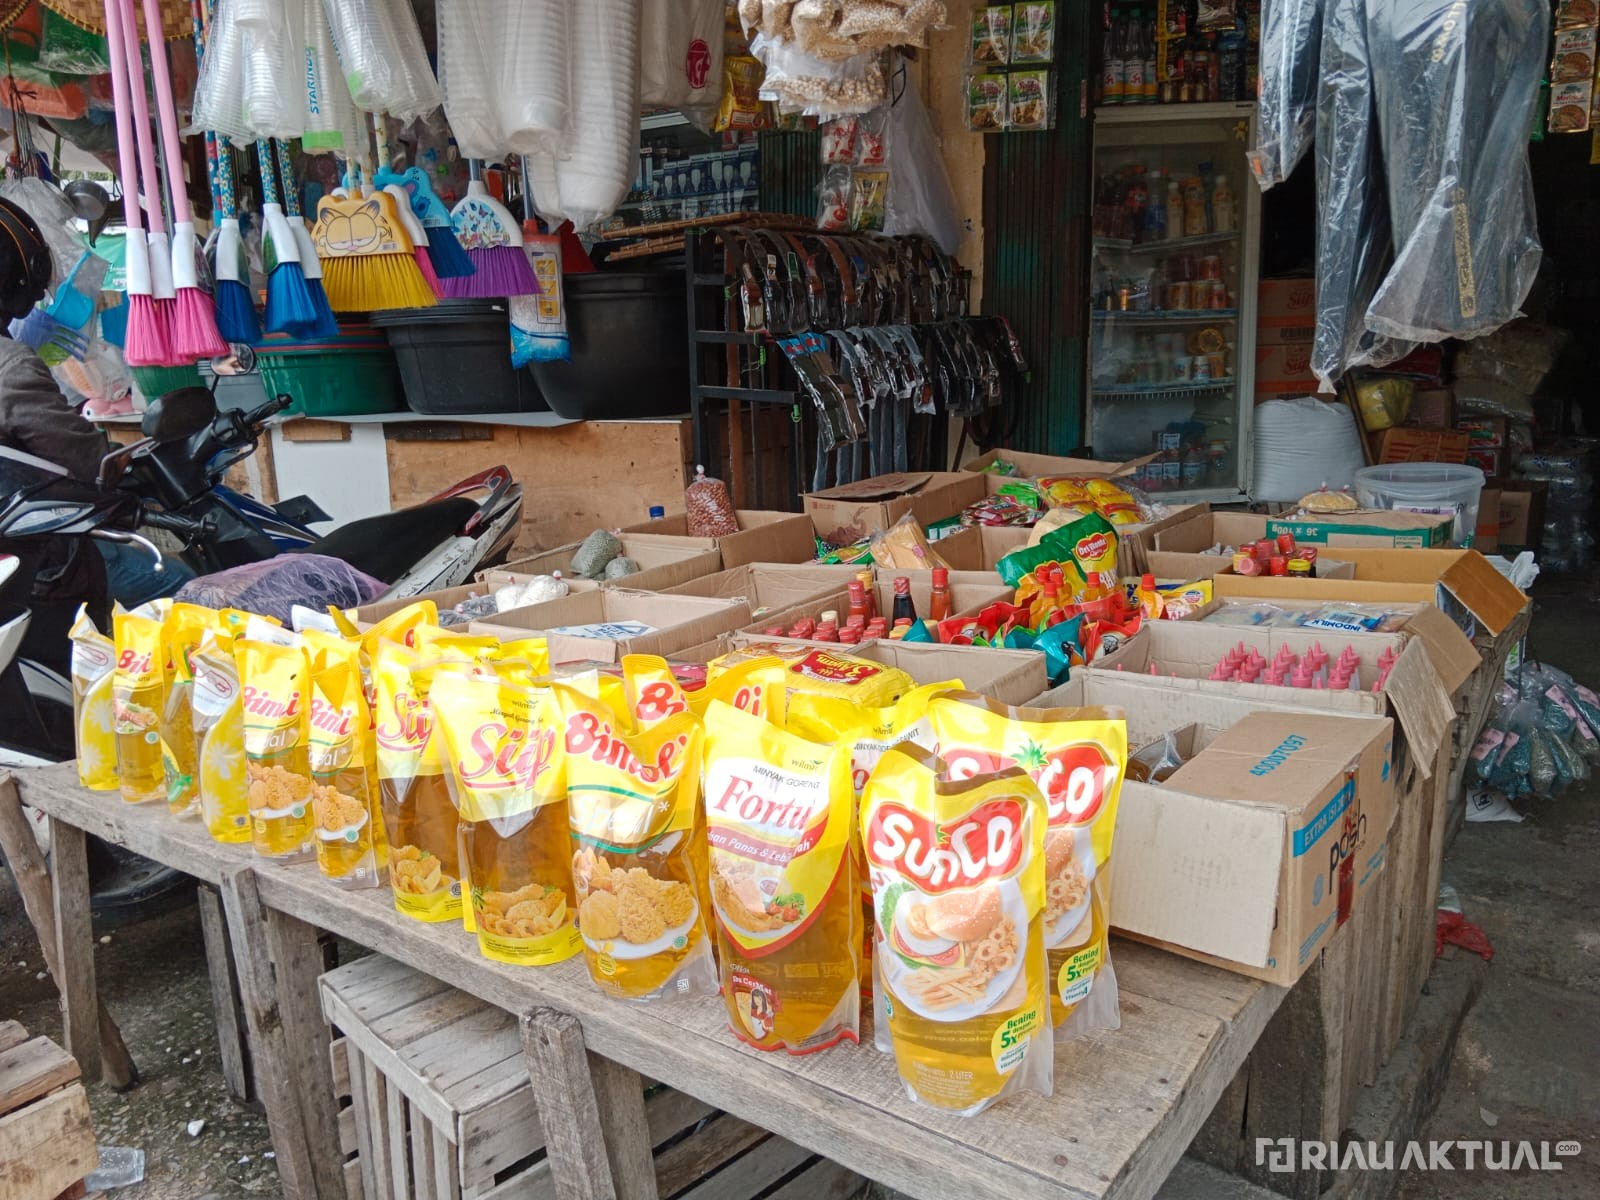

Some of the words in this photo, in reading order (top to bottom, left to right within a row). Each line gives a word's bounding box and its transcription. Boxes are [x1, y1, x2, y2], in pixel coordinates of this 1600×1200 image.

[1312, 619, 1361, 633] INDOMILK
[845, 665, 873, 678] 3
[1248, 734, 1308, 778] 40007097
[752, 764, 786, 783] MINYAK
[786, 777, 821, 790] GORENG
[950, 756, 1095, 820] SCO
[713, 774, 813, 831] Fortu
[1304, 816, 1328, 847] EXTRA
[729, 837, 758, 855] Panas
[759, 847, 769, 857] &
[1328, 798, 1367, 895] posh
[1073, 947, 1099, 963] Bening
[1067, 964, 1082, 982] 5x
[1007, 1010, 1036, 1029] Bening
[1001, 1031, 1017, 1049] 5x
